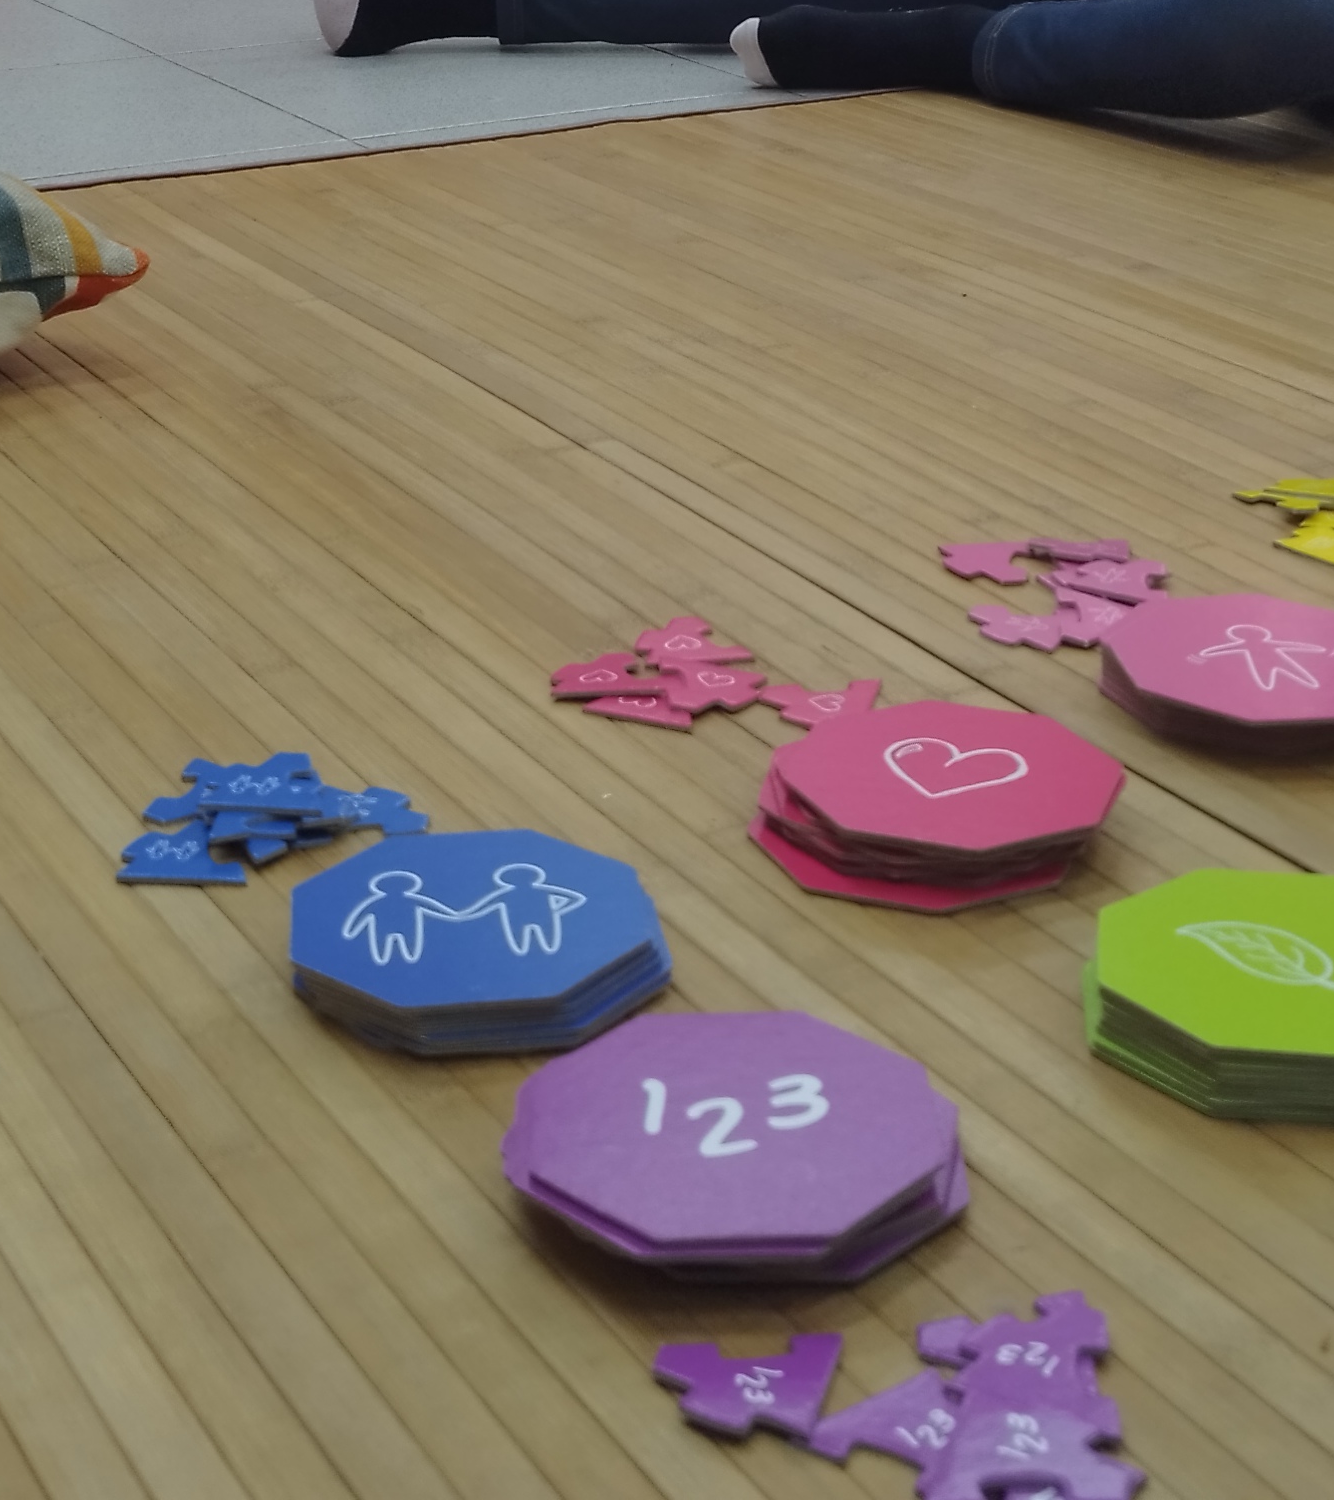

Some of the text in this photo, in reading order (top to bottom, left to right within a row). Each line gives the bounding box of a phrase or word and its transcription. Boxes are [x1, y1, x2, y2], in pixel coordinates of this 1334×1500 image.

[640, 1073, 831, 1158] 123
[994, 1340, 1060, 1379] 123
[733, 1364, 785, 1406] 123
[895, 1407, 957, 1451] 123
[995, 1411, 1050, 1462] 123
